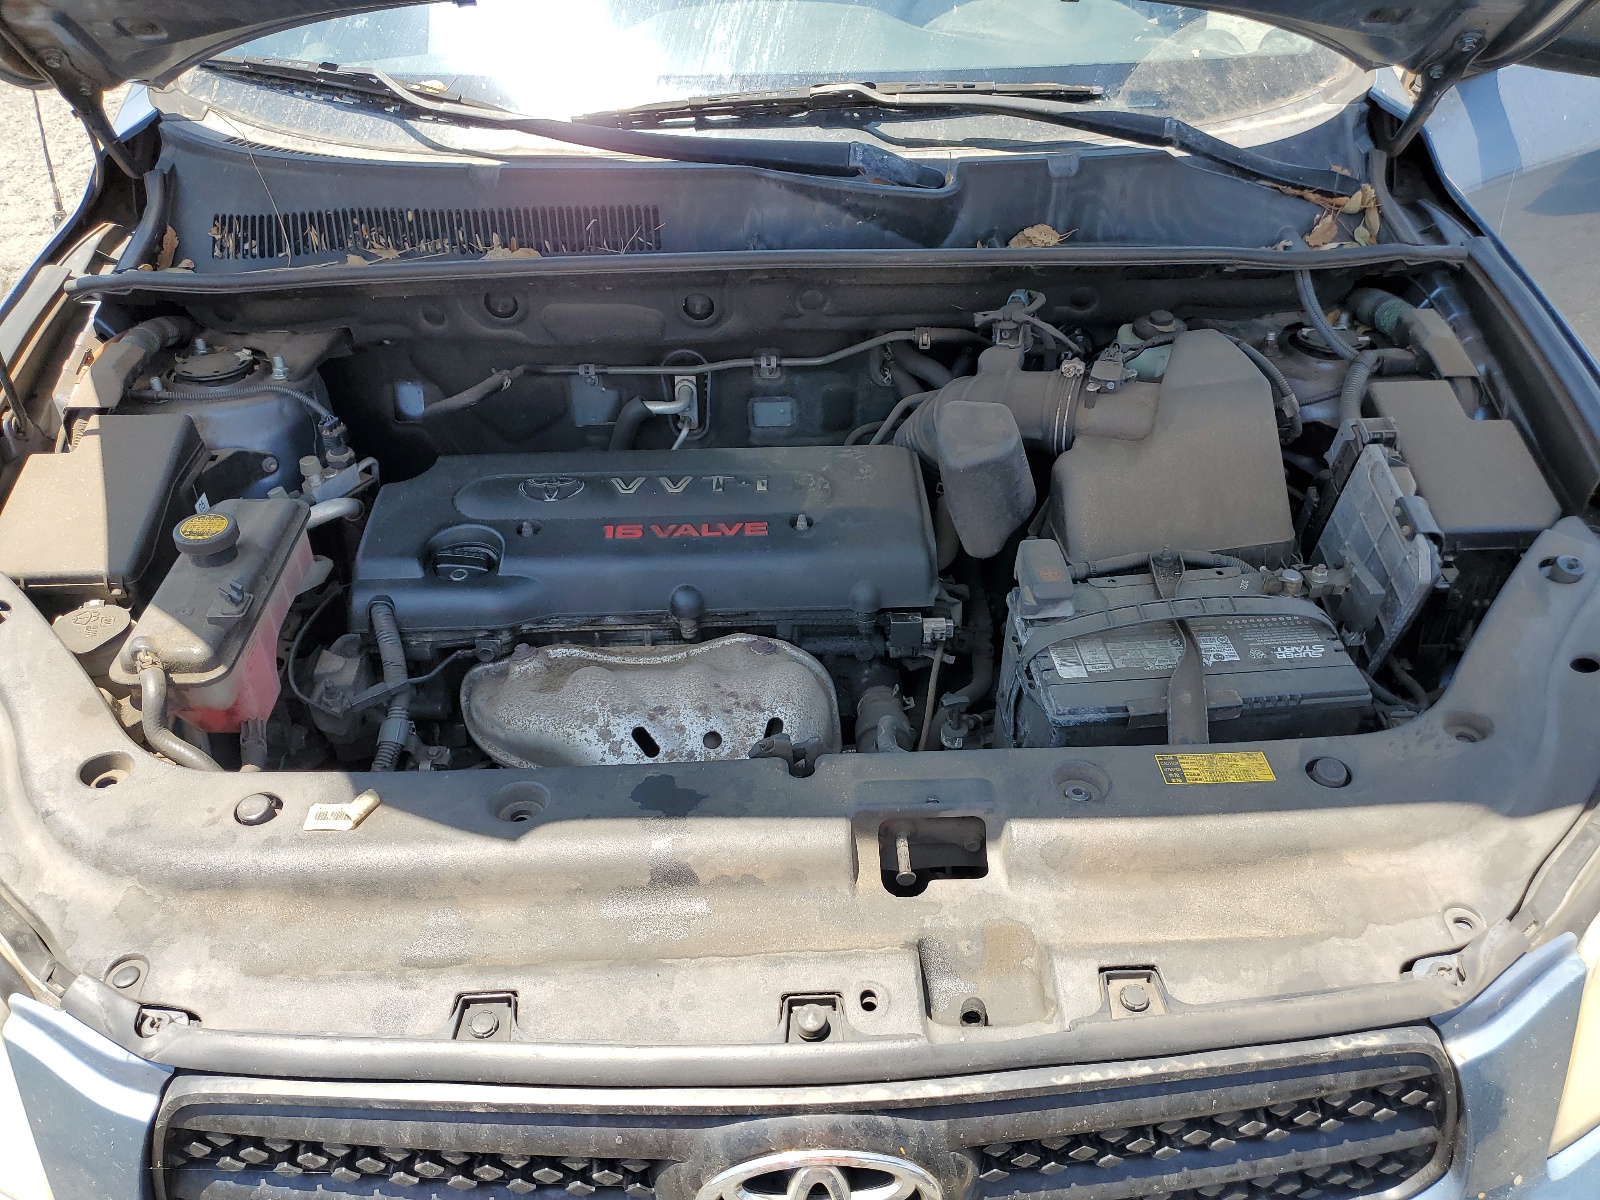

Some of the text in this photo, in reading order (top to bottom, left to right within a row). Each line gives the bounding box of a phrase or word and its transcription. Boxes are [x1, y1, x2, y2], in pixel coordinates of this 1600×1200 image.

[604, 522, 769, 539] 16 VALVE
[1274, 644, 1325, 652] START
[1275, 651, 1323, 659] SUPER
